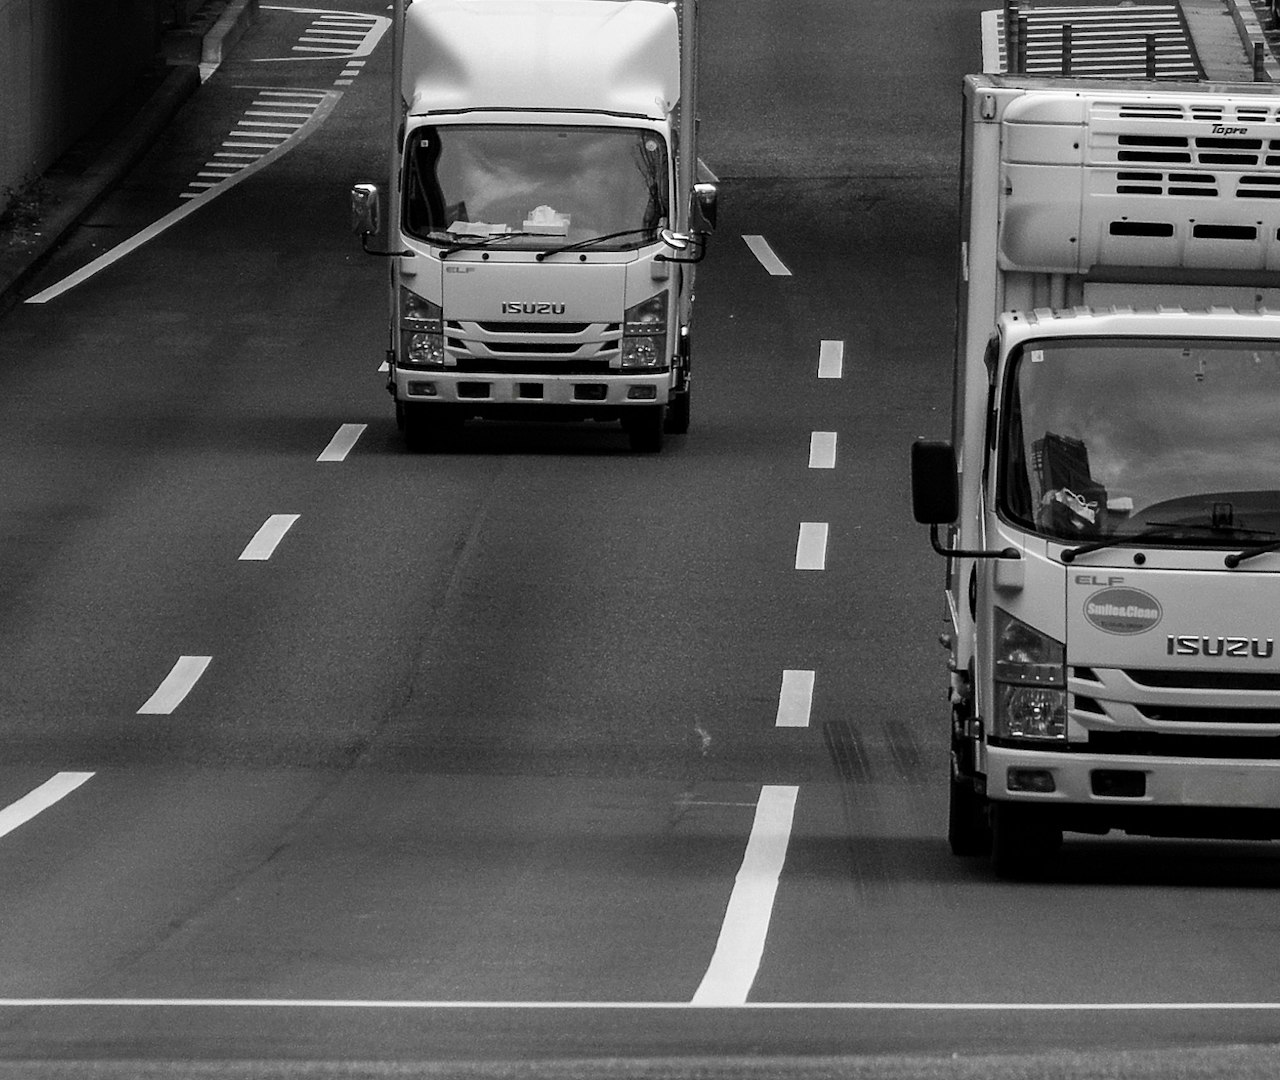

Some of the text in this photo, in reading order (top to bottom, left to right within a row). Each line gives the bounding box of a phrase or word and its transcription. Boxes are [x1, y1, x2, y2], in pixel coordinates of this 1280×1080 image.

[502, 302, 566, 315] ISUZU
[1075, 575, 1125, 586] ELF
[1087, 602, 1158, 620] Smile&Clean
[1167, 634, 1274, 659] ISUZU
